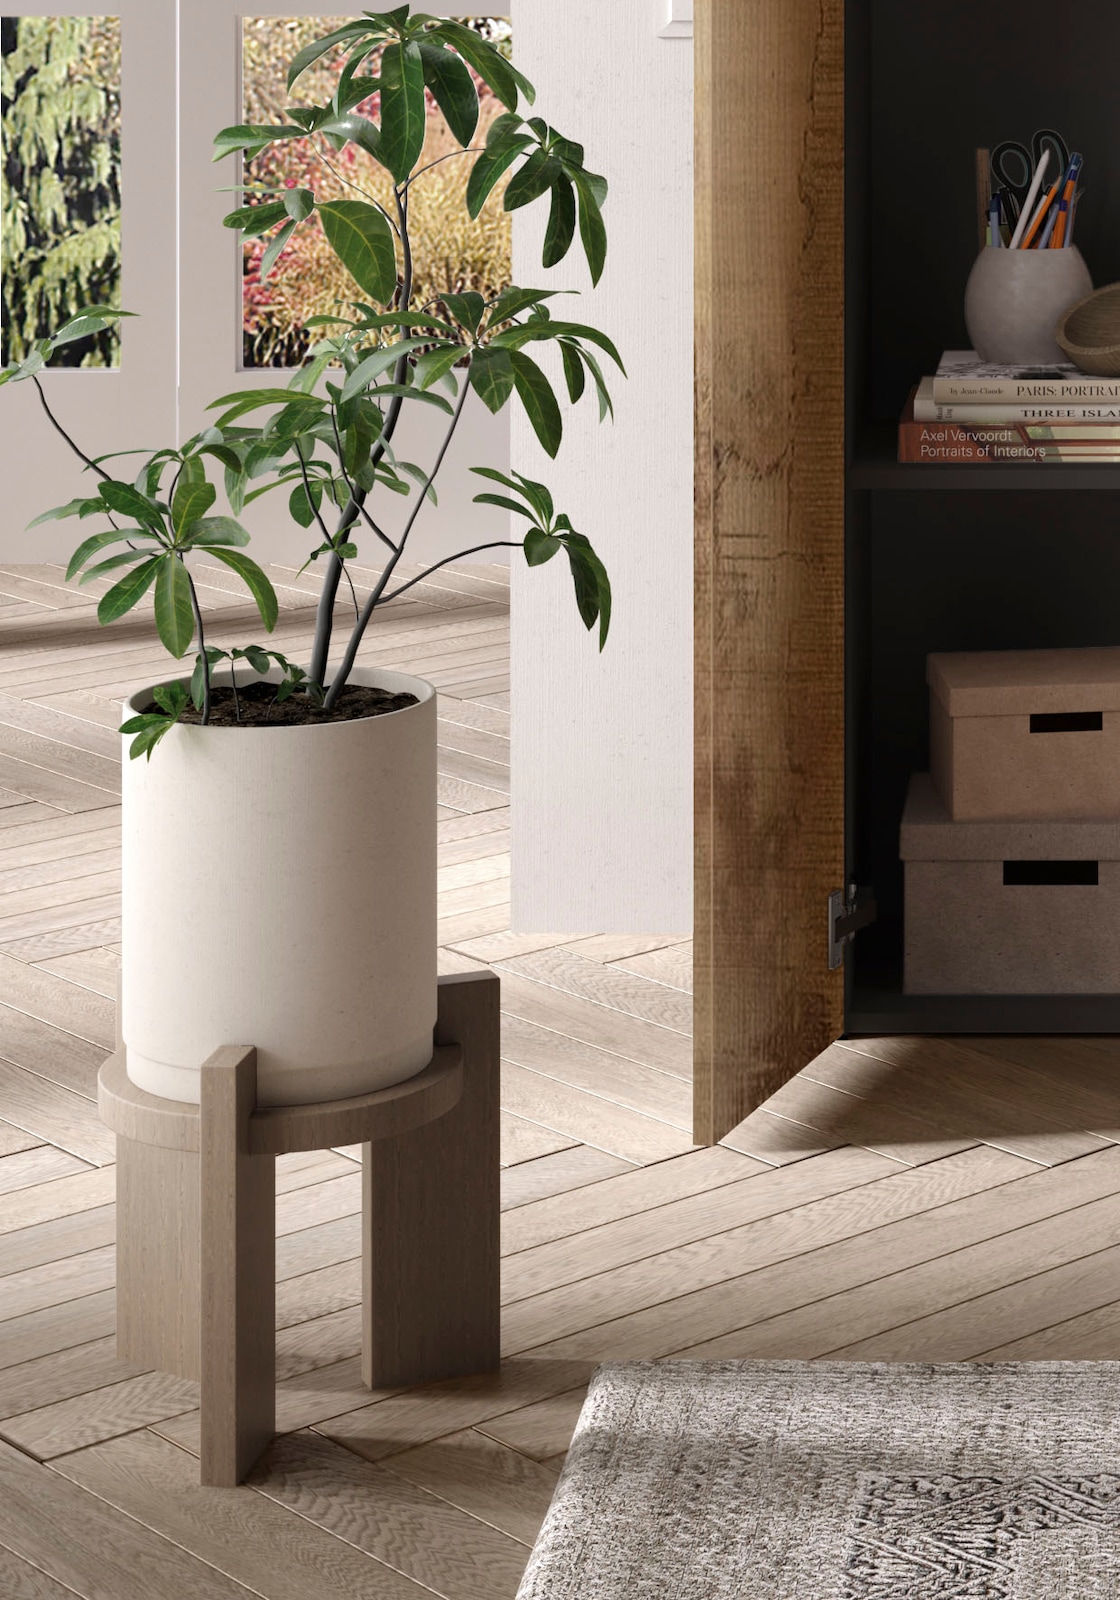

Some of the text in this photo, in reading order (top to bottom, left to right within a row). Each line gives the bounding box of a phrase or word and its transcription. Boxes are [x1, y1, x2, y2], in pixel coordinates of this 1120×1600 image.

[949, 387, 1004, 397] by Jean-Claude
[1016, 385, 1057, 397] PARIS:
[1020, 409, 1076, 418] THREE
[920, 429, 1012, 442] Axel Vervoordt
[920, 445, 1046, 458] Portraits of Interiors
